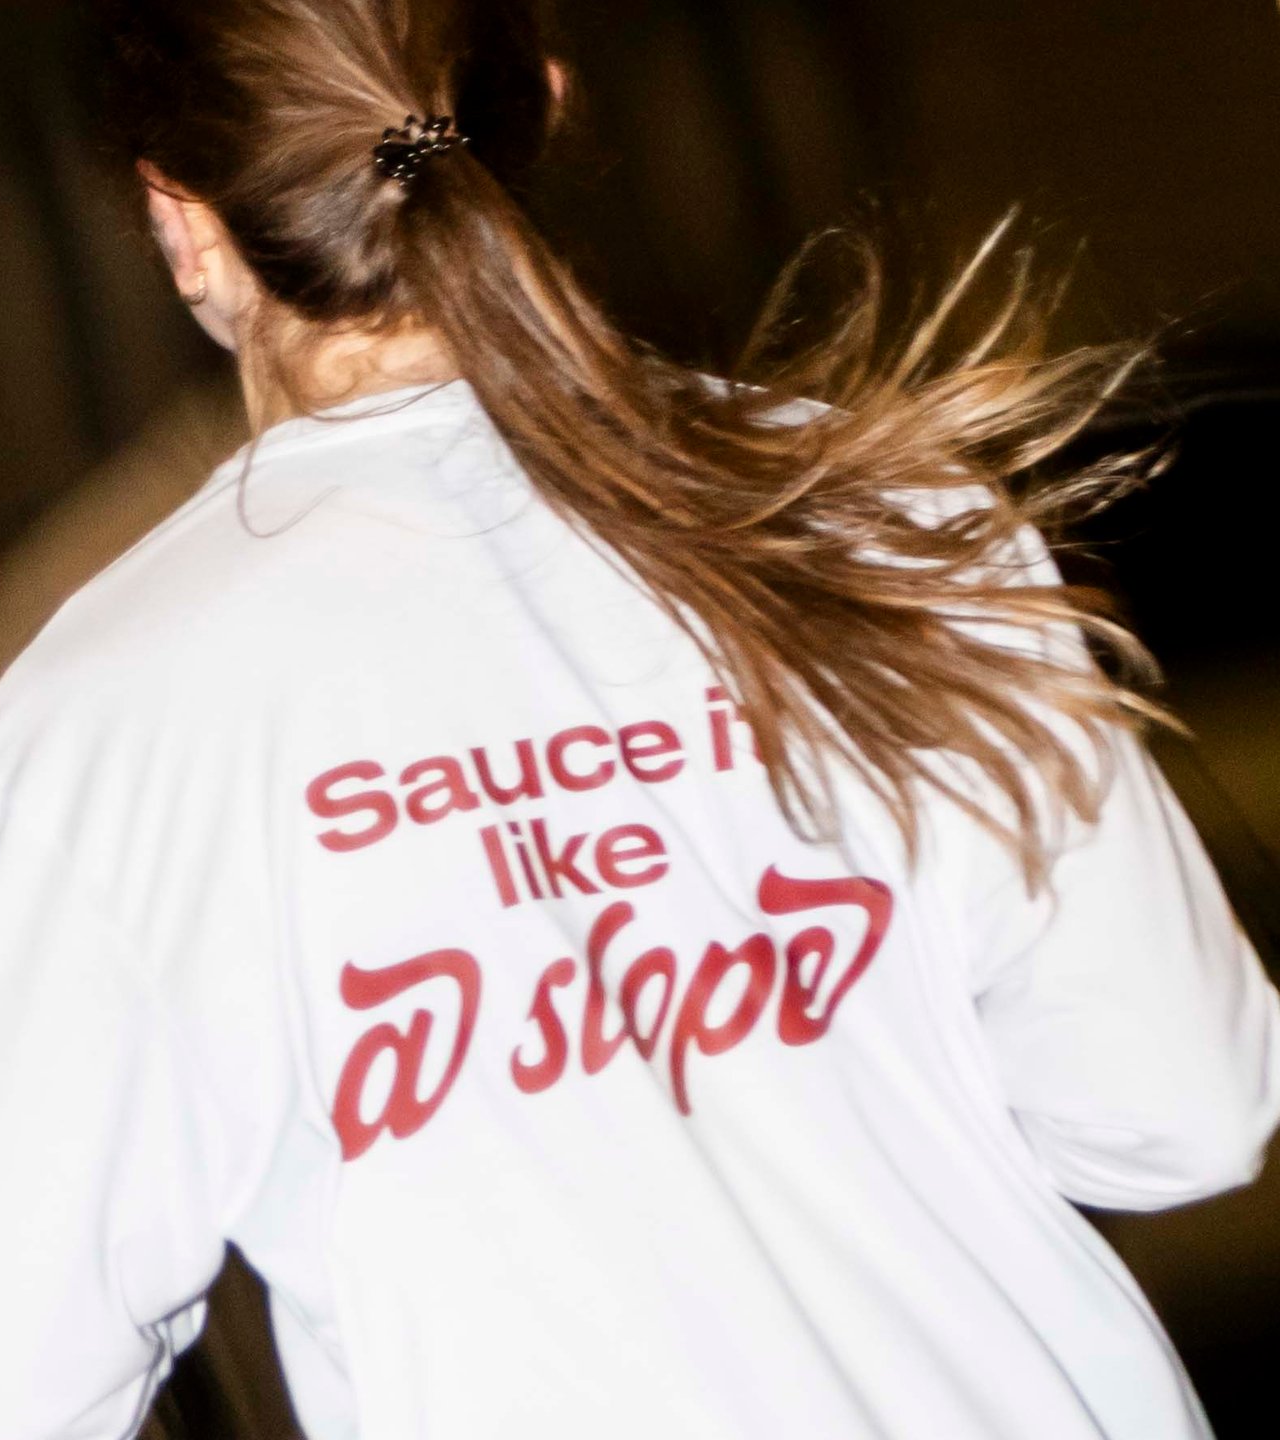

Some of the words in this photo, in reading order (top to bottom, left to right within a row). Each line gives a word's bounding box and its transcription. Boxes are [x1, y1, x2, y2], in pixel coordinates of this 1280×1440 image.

[304, 719, 687, 853] Sauce
[703, 684, 766, 772] i
[478, 817, 670, 909] like
[330, 947, 482, 1163] a
[510, 862, 894, 1118] slope
